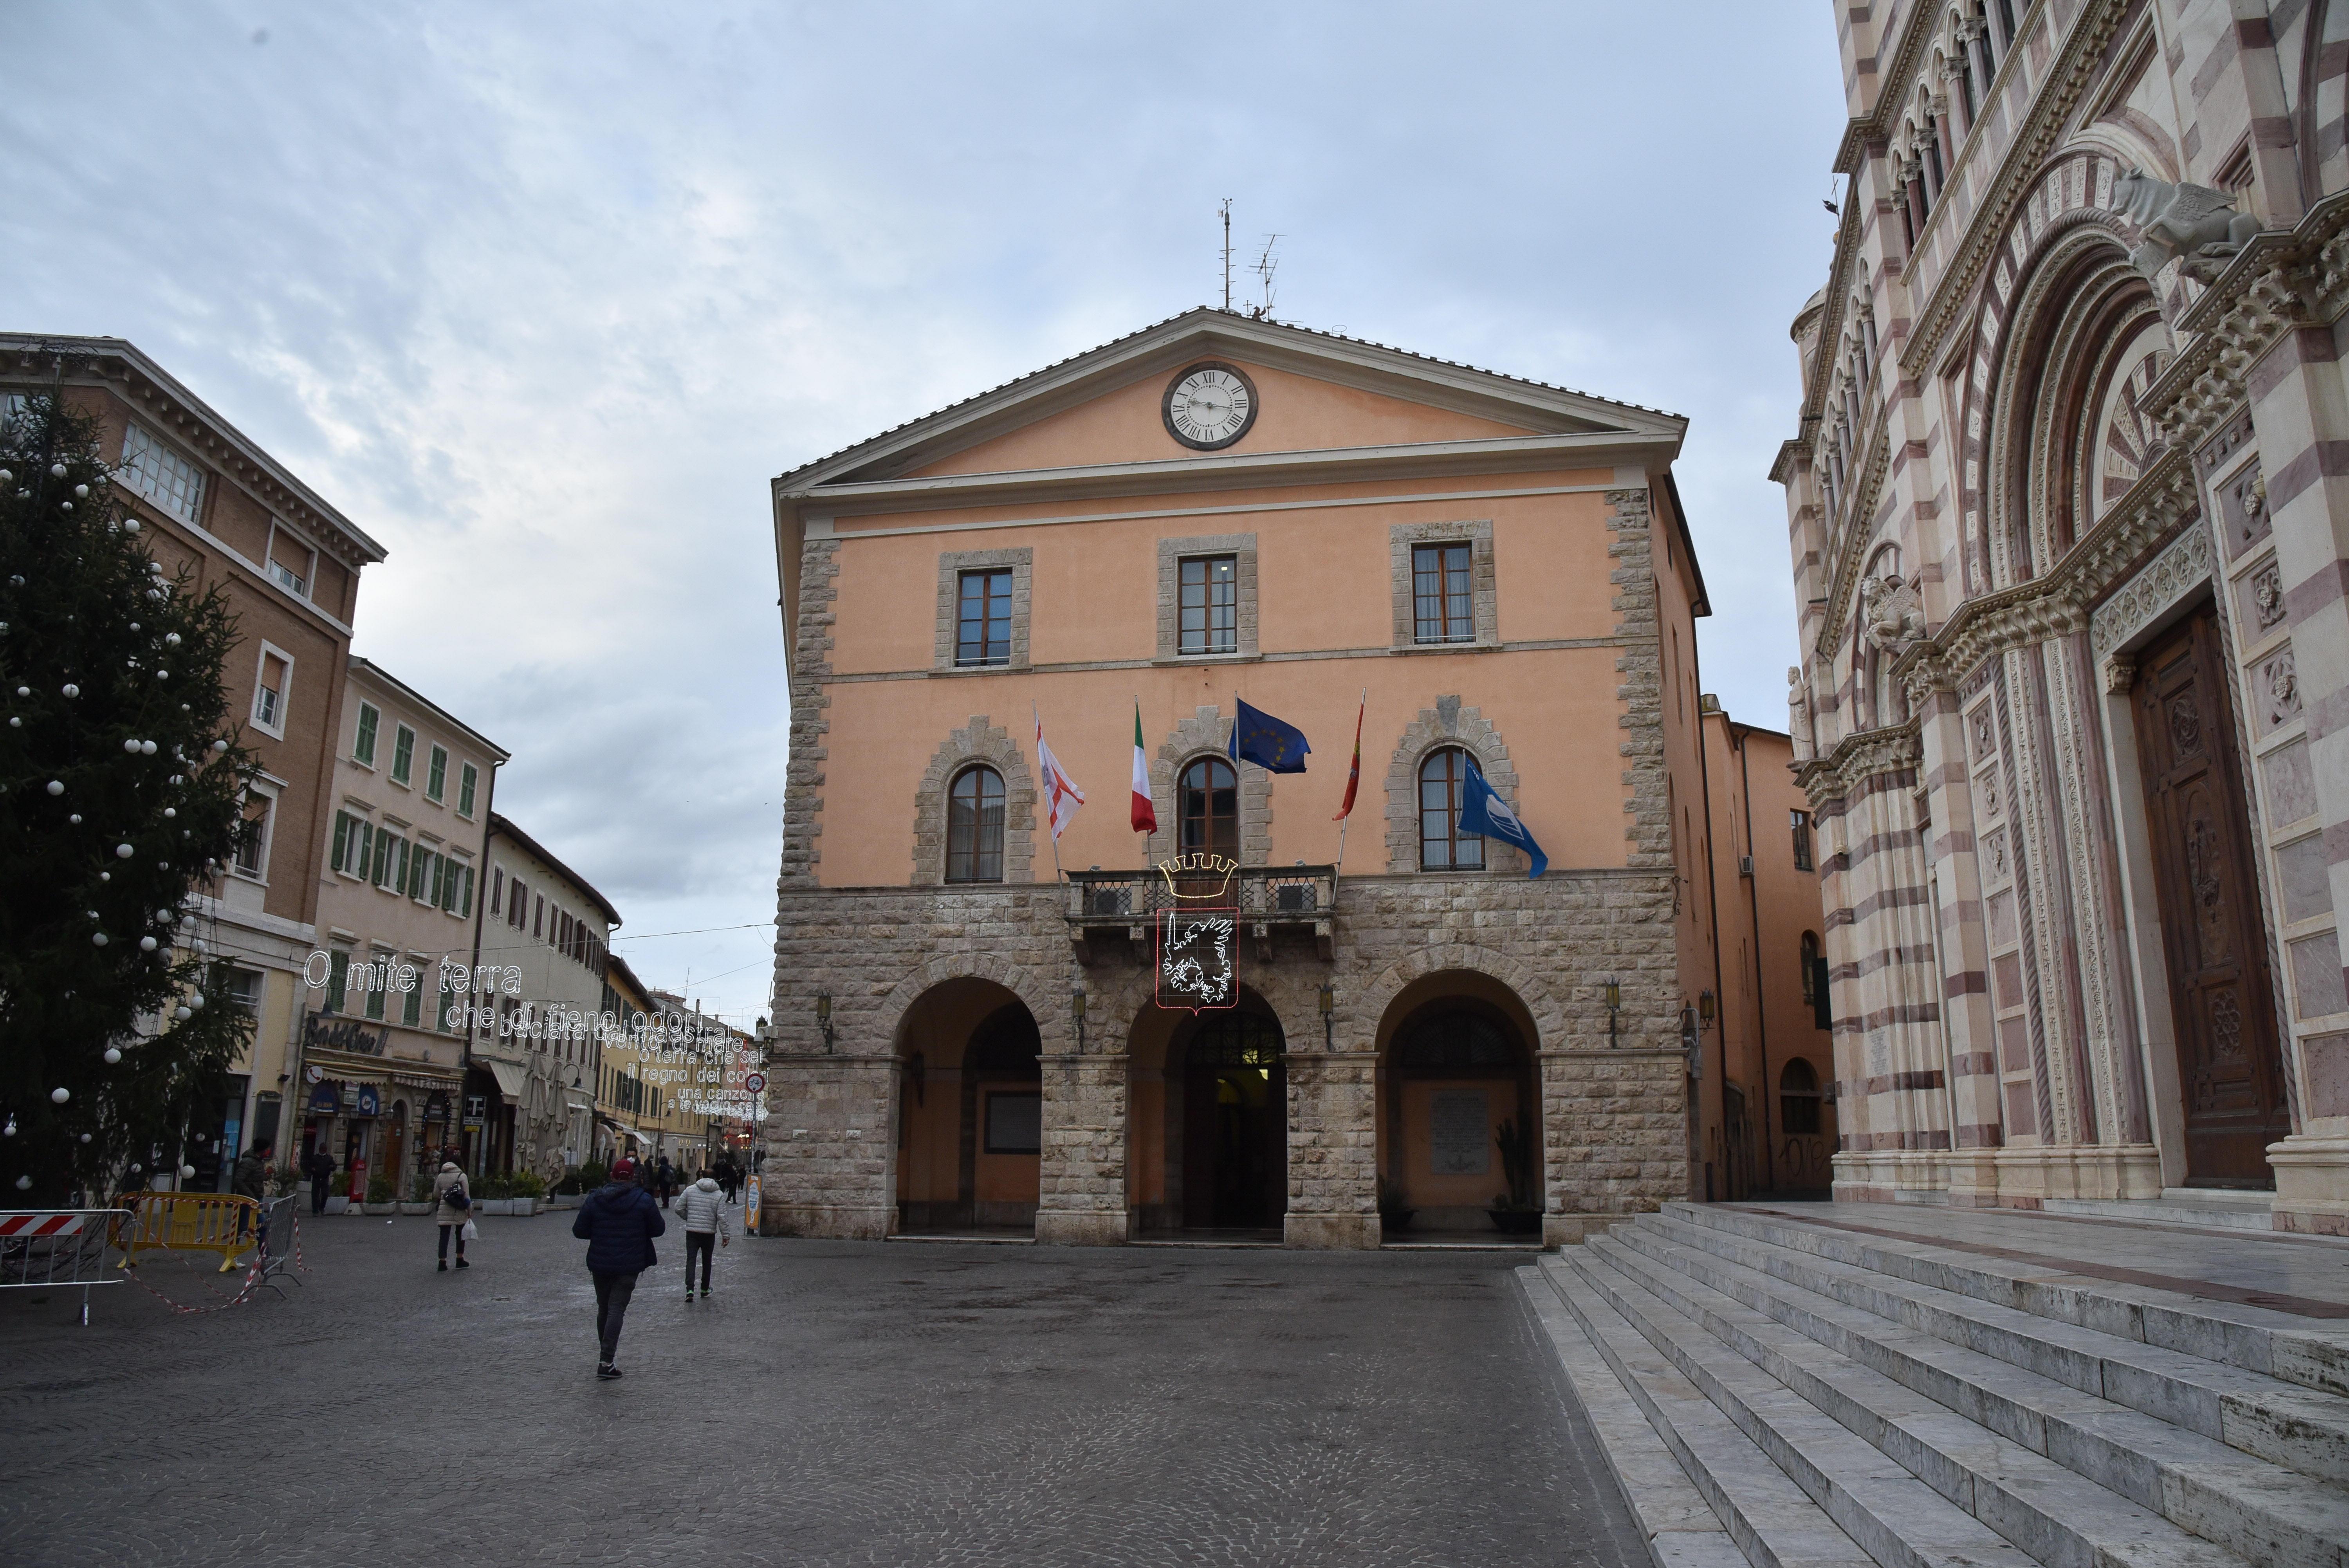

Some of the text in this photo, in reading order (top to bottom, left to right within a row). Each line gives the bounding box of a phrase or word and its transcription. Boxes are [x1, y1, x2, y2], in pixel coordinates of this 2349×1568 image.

[1185, 377, 1200, 391] XI
[1203, 372, 1215, 384] XII
[1176, 389, 1189, 399] X
[1231, 385, 1244, 395] II
[1235, 399, 1247, 408] III
[1188, 425, 1201, 439] VII
[1205, 429, 1214, 441] VI
[1222, 425, 1230, 436] V
[303, 951, 521, 994] O mite terra
[446, 1001, 703, 1033] che di fieno odori
[500, 1014, 733, 1043] baciata dal maestral
[604, 1032, 744, 1053] vento di mare
[639, 1045, 763, 1065] o terra che sei
[627, 1063, 636, 1079] il
[642, 1067, 687, 1085] regno
[697, 1066, 720, 1083] dei
[678, 1088, 702, 1099] una
[469, 1097, 483, 1115] T
[668, 1099, 675, 1109] a
